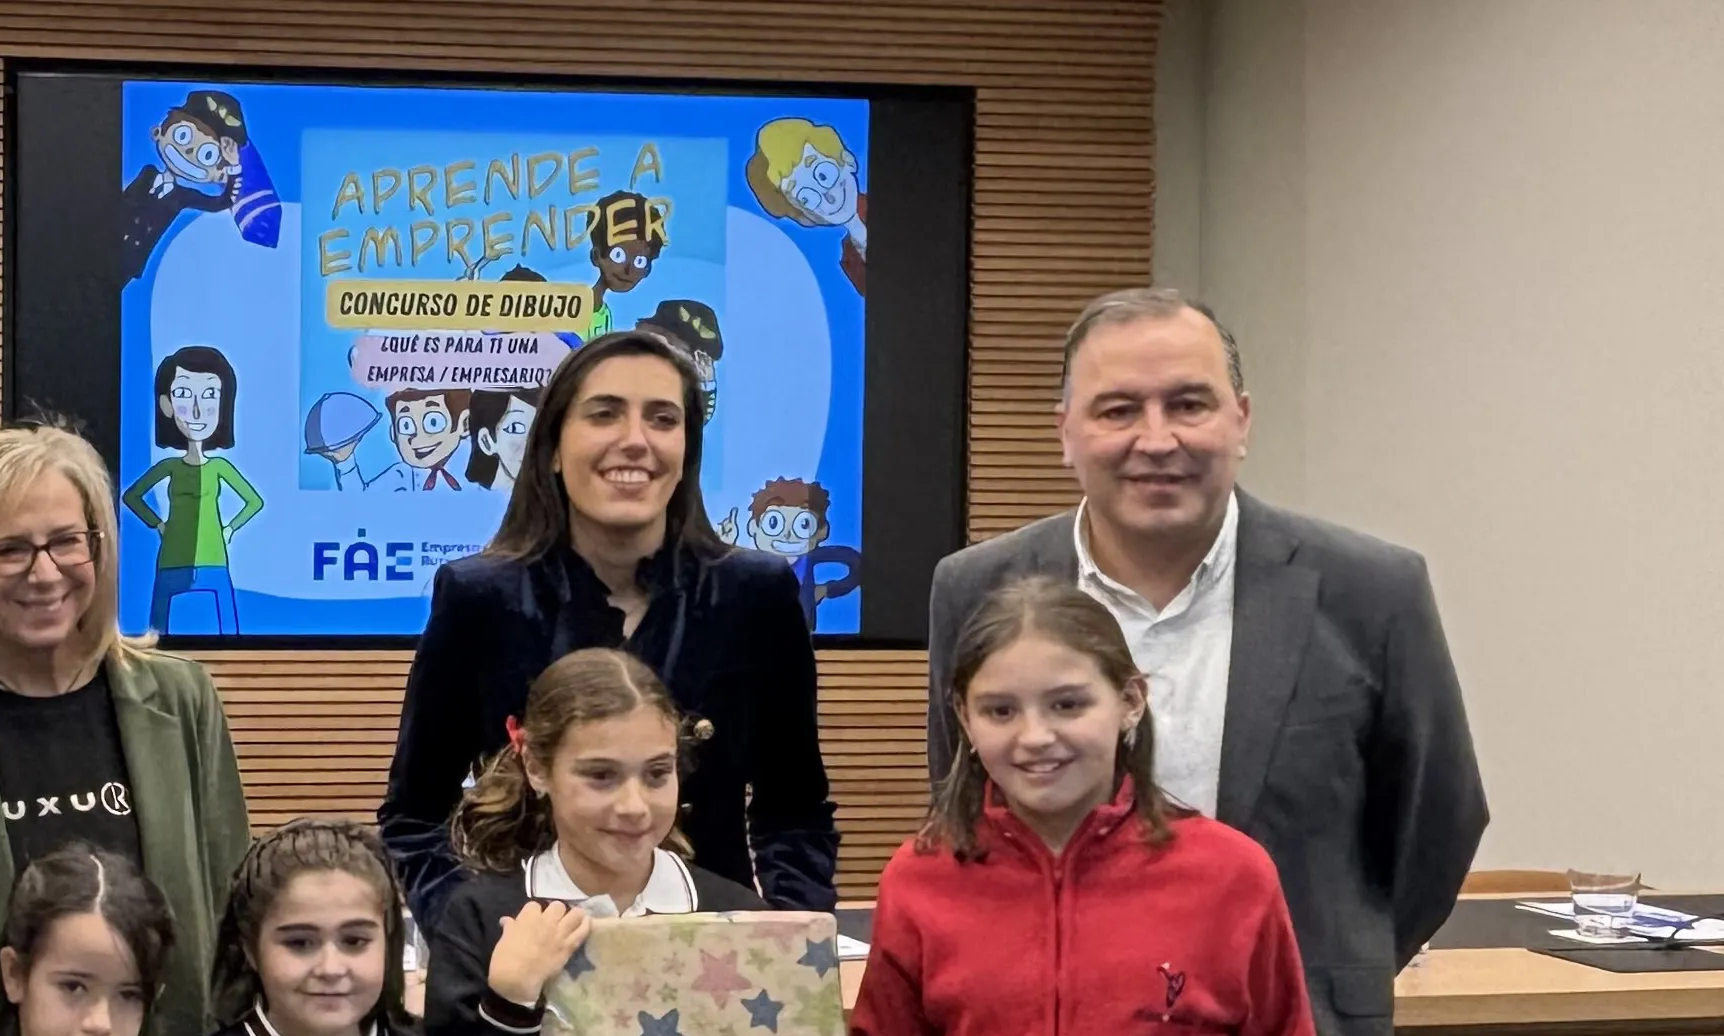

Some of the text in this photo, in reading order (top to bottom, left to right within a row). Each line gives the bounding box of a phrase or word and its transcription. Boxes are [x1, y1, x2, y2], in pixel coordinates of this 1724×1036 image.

[331, 142, 664, 219] APRENDE A
[319, 198, 672, 277] EMPRENDER
[339, 291, 581, 318] CONCURSO DE DIBUJO
[423, 337, 440, 354] ES
[444, 337, 483, 354] PARA
[489, 338, 502, 354] TI
[508, 338, 538, 354] UNA
[367, 365, 435, 383] EMPRESA
